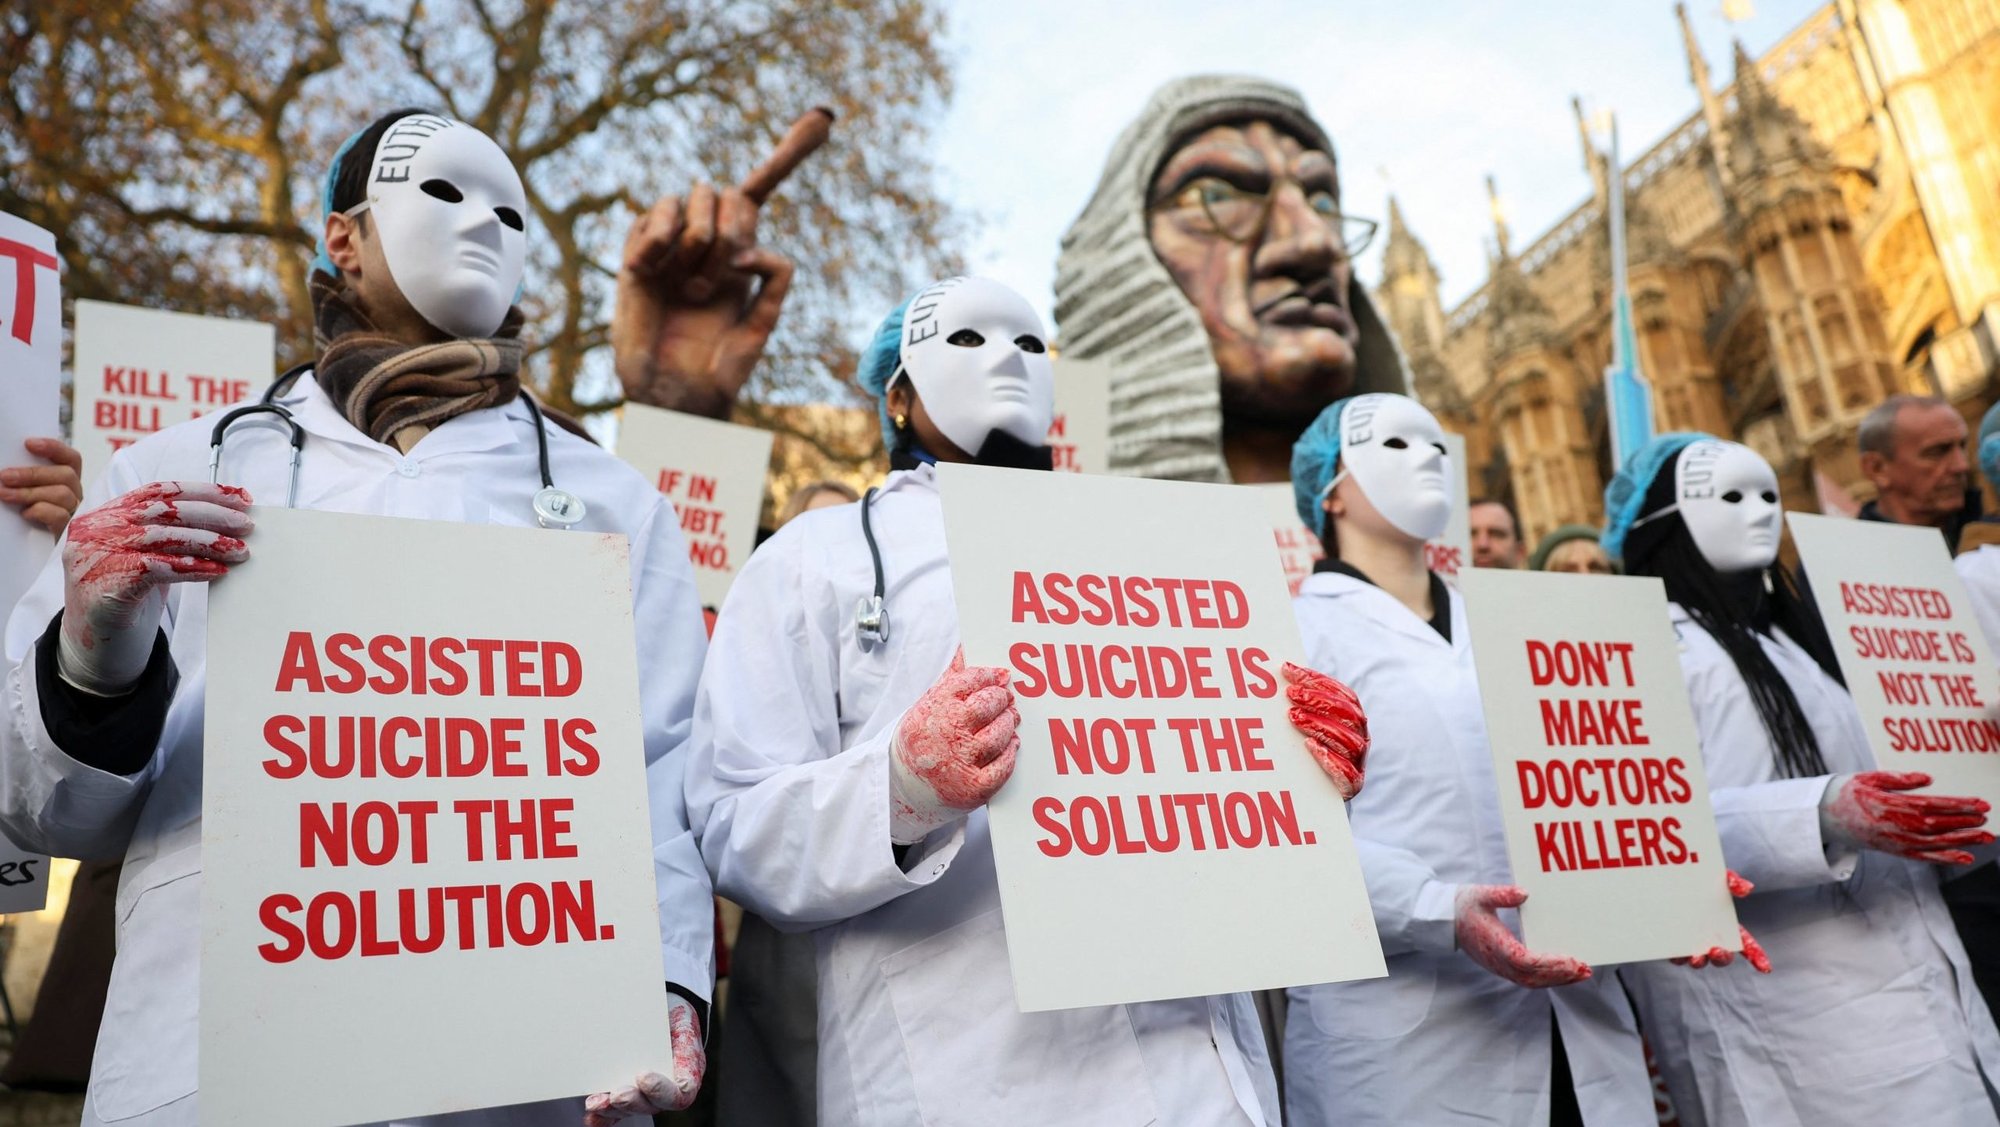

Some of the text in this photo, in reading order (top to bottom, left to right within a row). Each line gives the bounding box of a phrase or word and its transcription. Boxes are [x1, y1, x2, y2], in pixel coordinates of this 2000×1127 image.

[103, 367, 177, 400] KILL
[657, 469, 718, 504] IF IN
[689, 539, 732, 572] NO.
[1012, 571, 1250, 629] ASSISTED
[1839, 582, 1953, 621] ASSISTED
[275, 631, 583, 698] ASSISTED
[1008, 642, 1278, 699] SUICIDE IS
[1525, 640, 1636, 688] DON'T
[1849, 625, 1976, 665] SUICIDE IS
[1878, 671, 1984, 708] NOT THE
[262, 714, 601, 779] SUICIDE IS
[1048, 717, 1275, 776] NOT THE
[1539, 698, 1650, 747] MAKE
[1516, 756, 1693, 810] DOCTORS
[300, 798, 579, 868] NOT THE
[1032, 790, 1317, 858] SOLUTION.
[1534, 816, 1699, 873] KILLERS.
[258, 880, 616, 964] SOLUTION.
